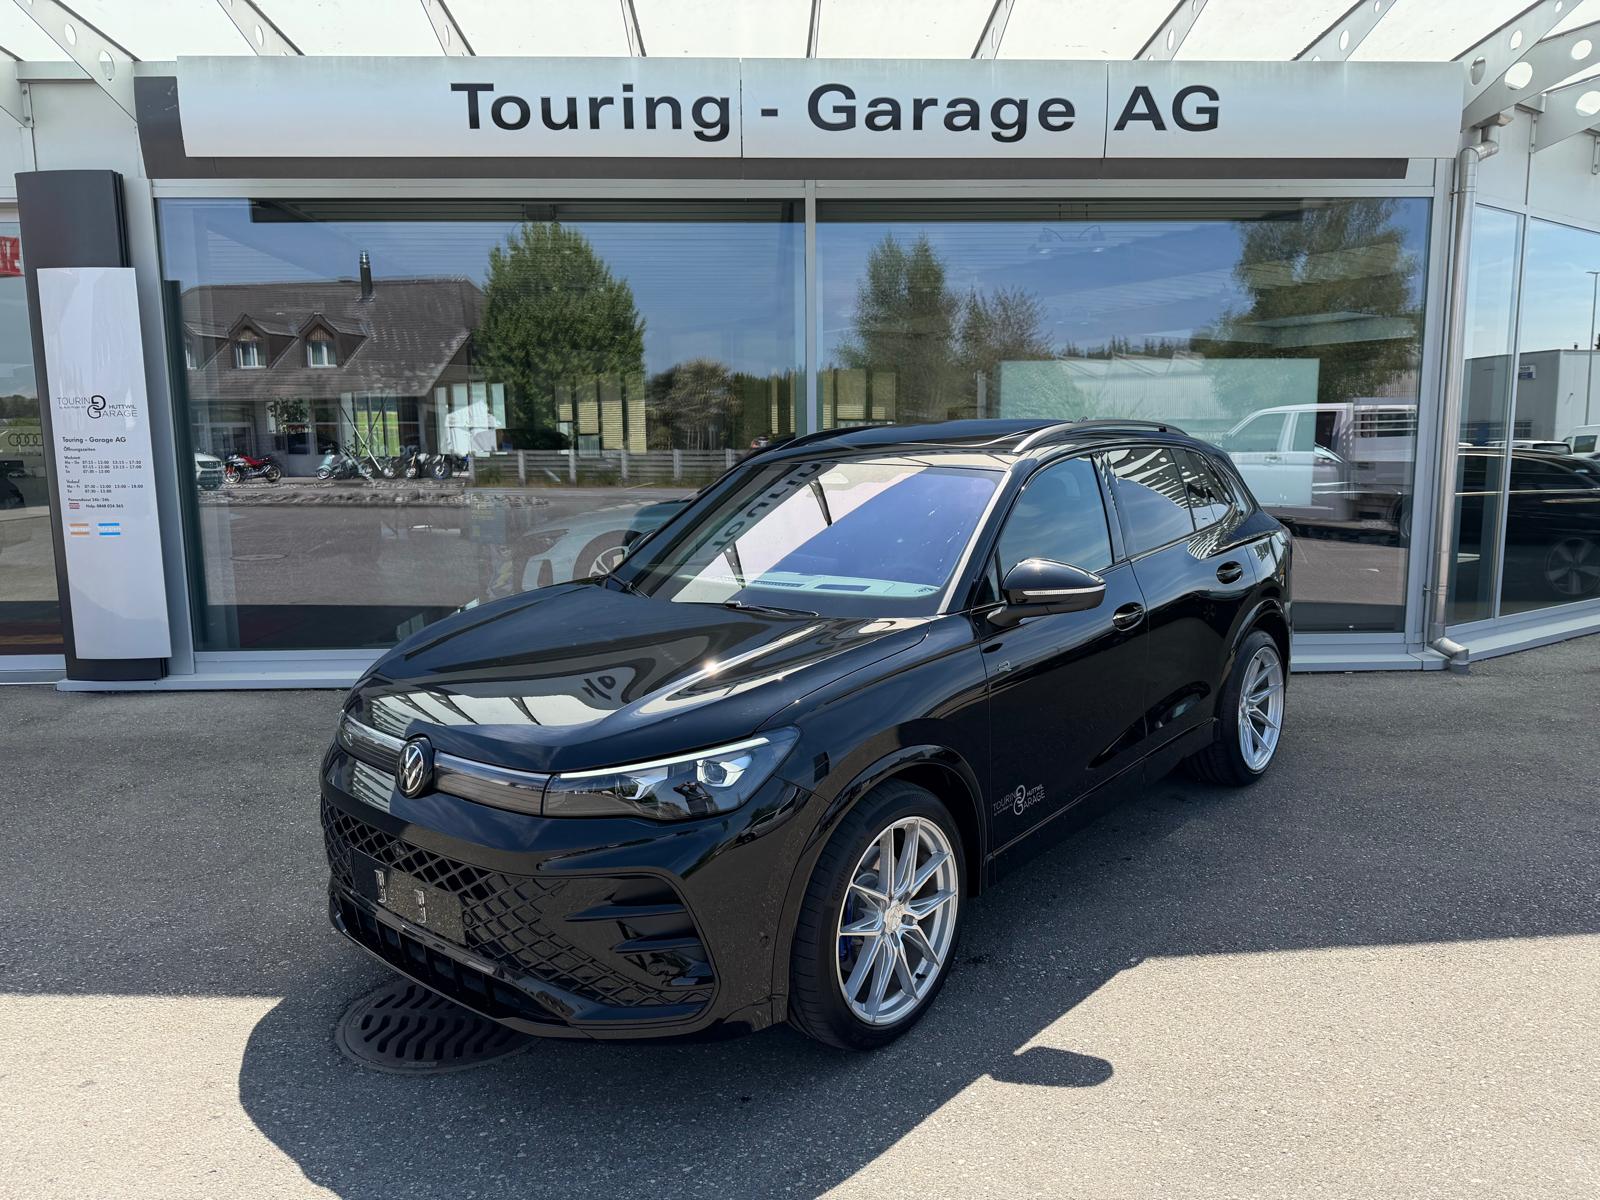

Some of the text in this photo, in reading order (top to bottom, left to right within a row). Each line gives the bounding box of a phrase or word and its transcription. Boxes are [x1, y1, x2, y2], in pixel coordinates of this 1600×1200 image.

[450, 83, 1221, 143] Touring - Garage AG
[62, 436, 84, 444] Touring
[88, 436, 114, 444] Garage
